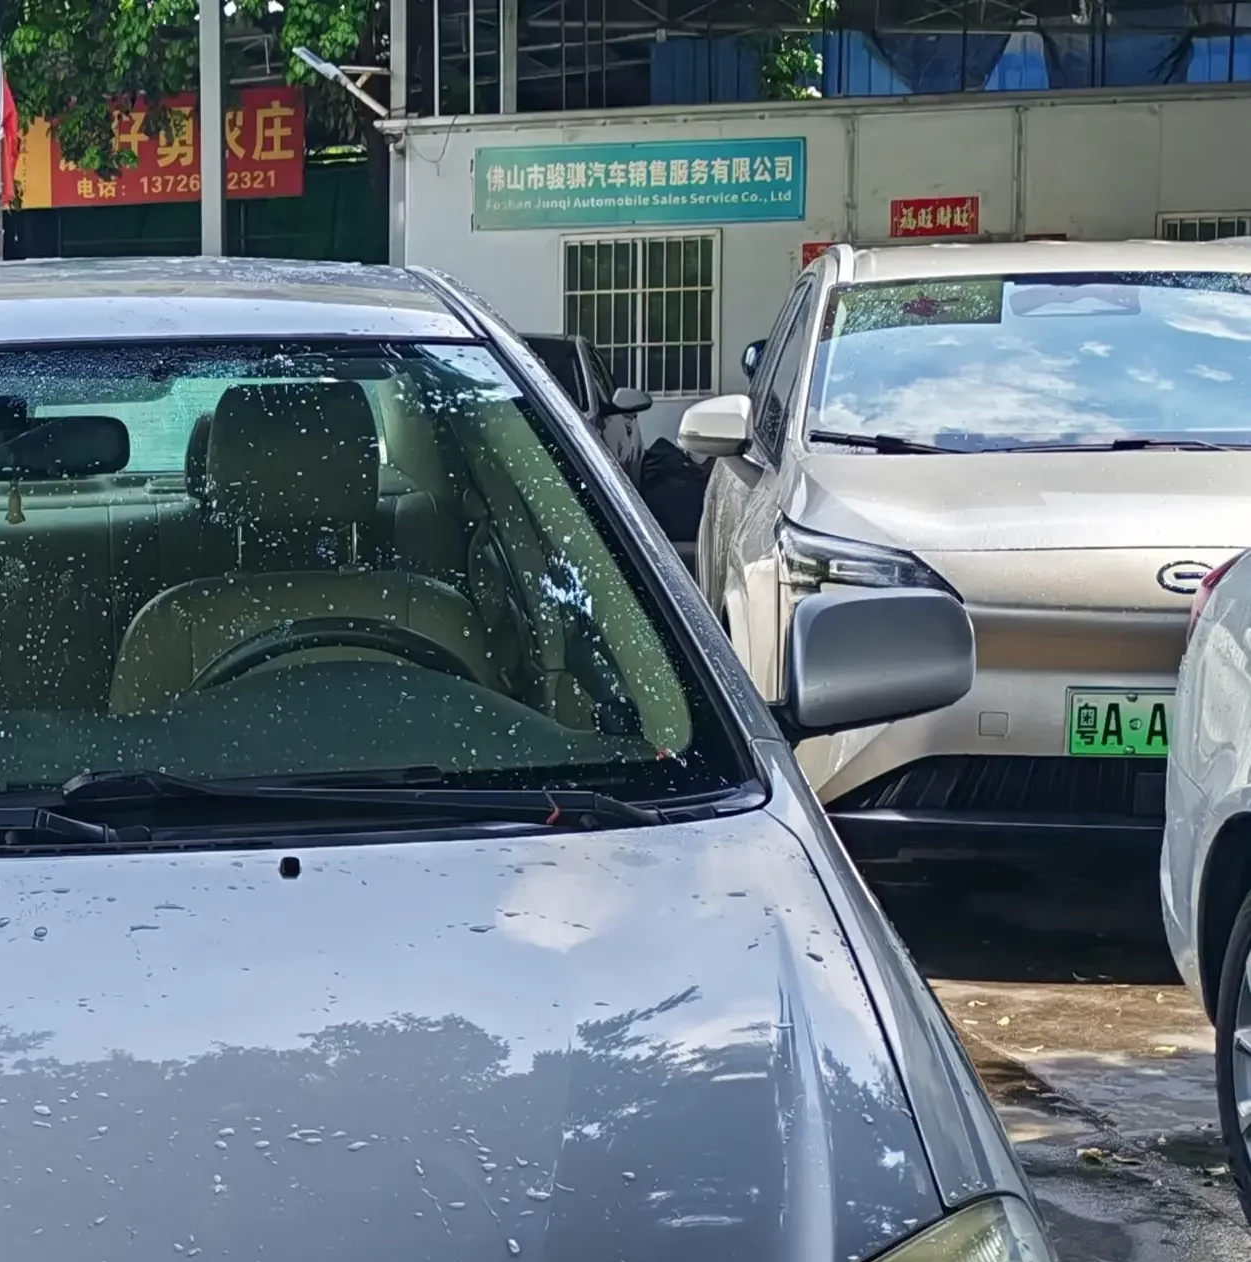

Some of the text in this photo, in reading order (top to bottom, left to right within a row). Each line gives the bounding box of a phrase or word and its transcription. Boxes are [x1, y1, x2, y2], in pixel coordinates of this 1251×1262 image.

[58, 100, 295, 171] 仔勇庄
[140, 170, 276, 194] 137262321
[535, 196, 571, 211] Junqi
[574, 194, 650, 208] Automobile
[652, 193, 687, 206] Sales
[690, 191, 739, 204] Service
